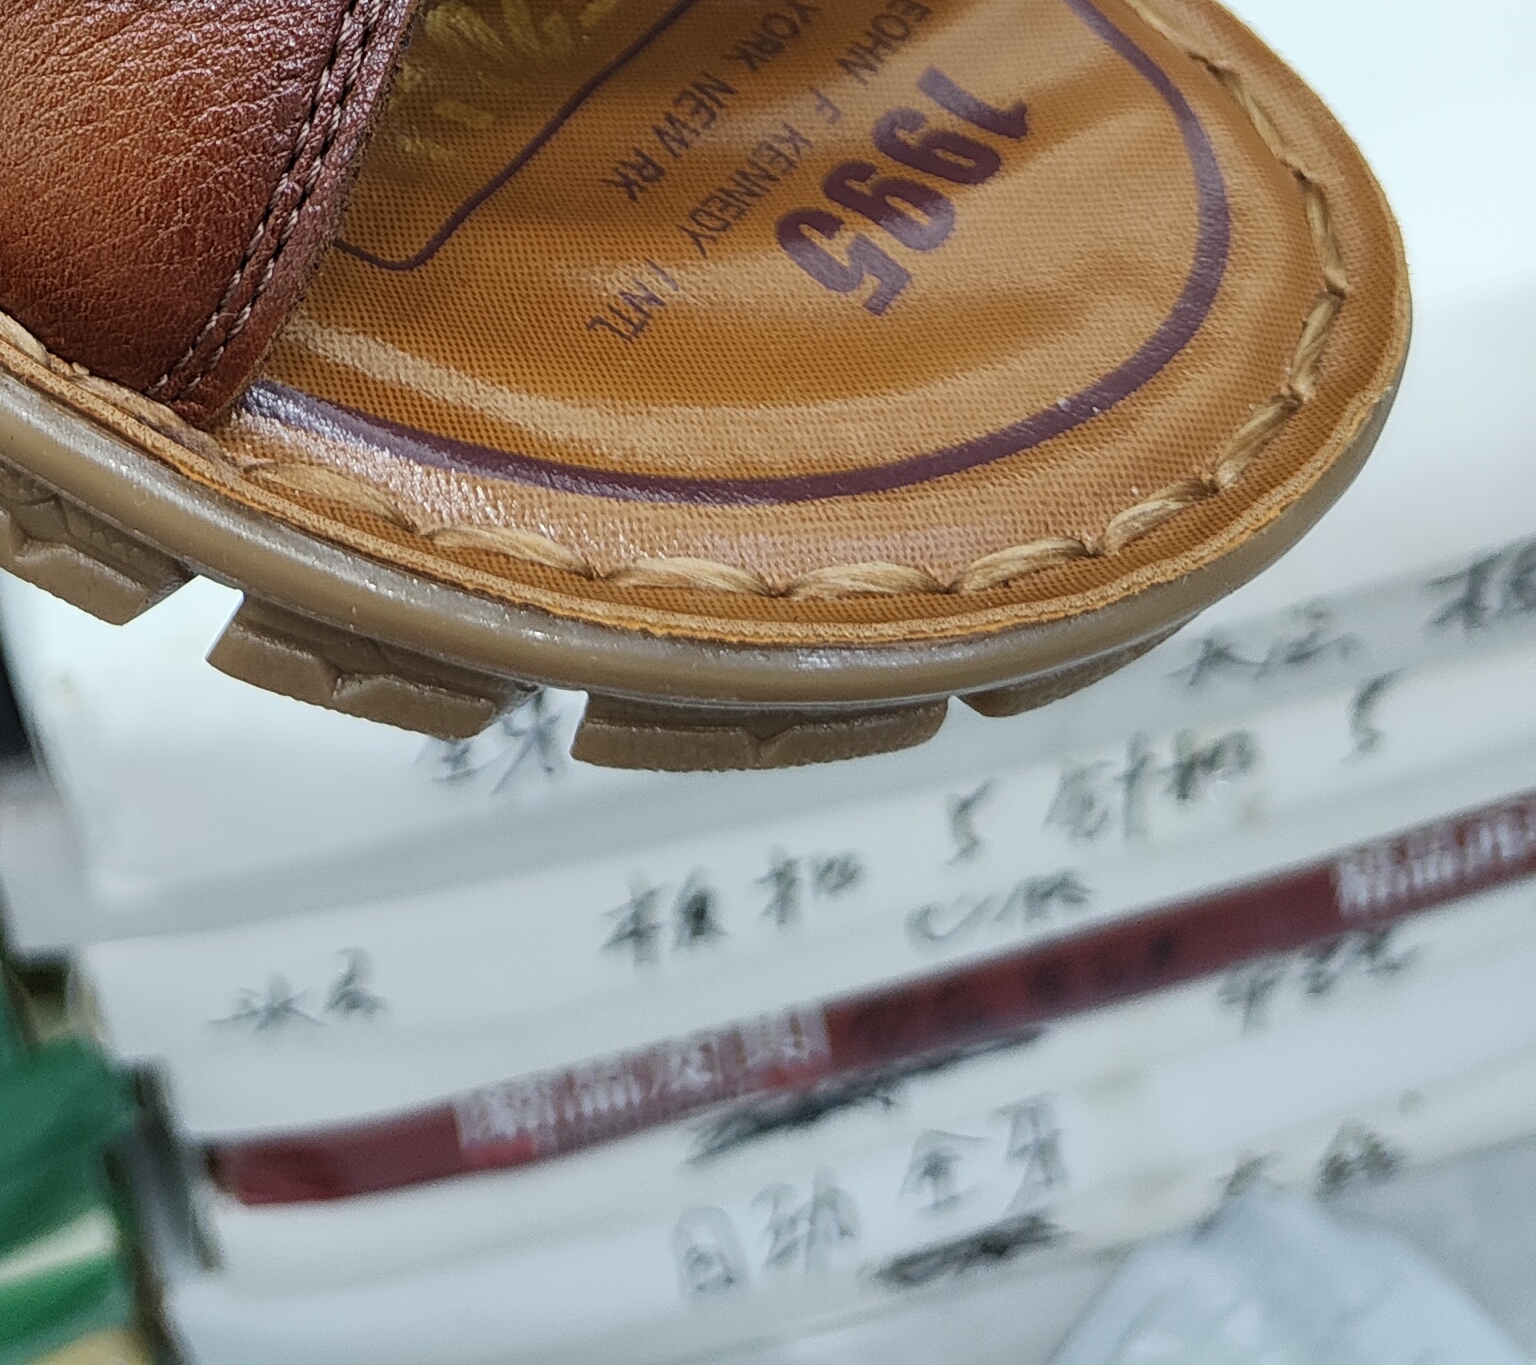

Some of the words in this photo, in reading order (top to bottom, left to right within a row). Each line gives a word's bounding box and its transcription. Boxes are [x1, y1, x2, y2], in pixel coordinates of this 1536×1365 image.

[651, 71, 739, 159] NEW
[677, 123, 813, 258] KENNEDY
[774, 64, 1030, 317] 1995
